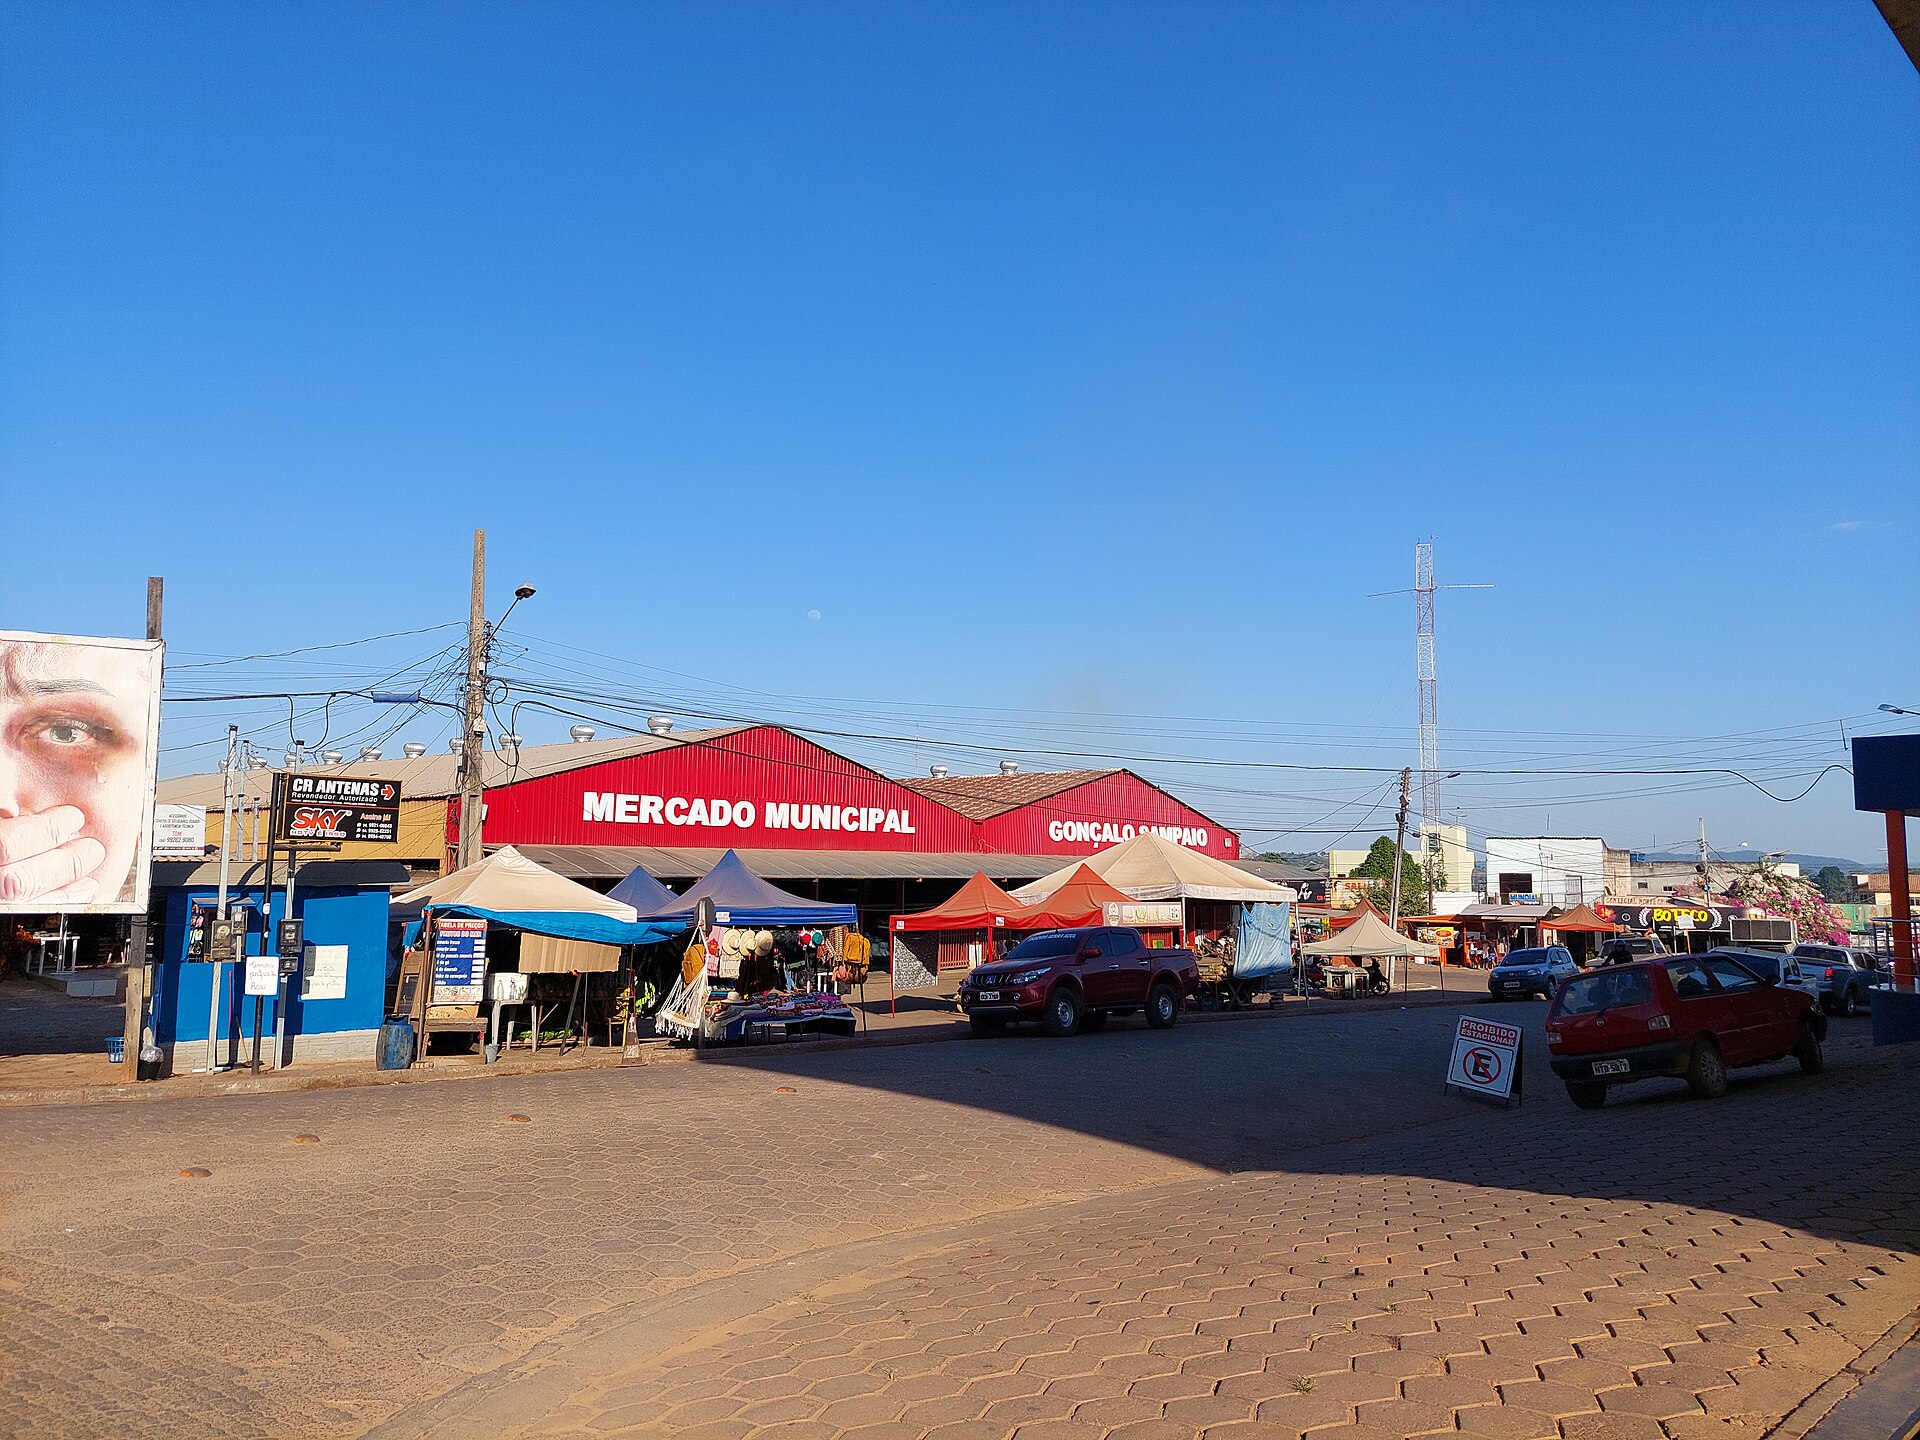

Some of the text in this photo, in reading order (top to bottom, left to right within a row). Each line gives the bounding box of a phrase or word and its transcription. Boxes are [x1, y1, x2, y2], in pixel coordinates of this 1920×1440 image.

[293, 778, 380, 796] CR ANTENAS
[292, 792, 336, 800] Revendedor
[340, 795, 378, 803] Autorizado
[291, 807, 347, 830] SKY
[583, 792, 916, 834] MERCADO MUNICIPAL
[1050, 820, 1136, 848] GONÇALO
[1460, 1028, 1514, 1046] ESTACIONAR
[1462, 1020, 1516, 1038] PROIBIDO
[1472, 1053, 1492, 1078] E
